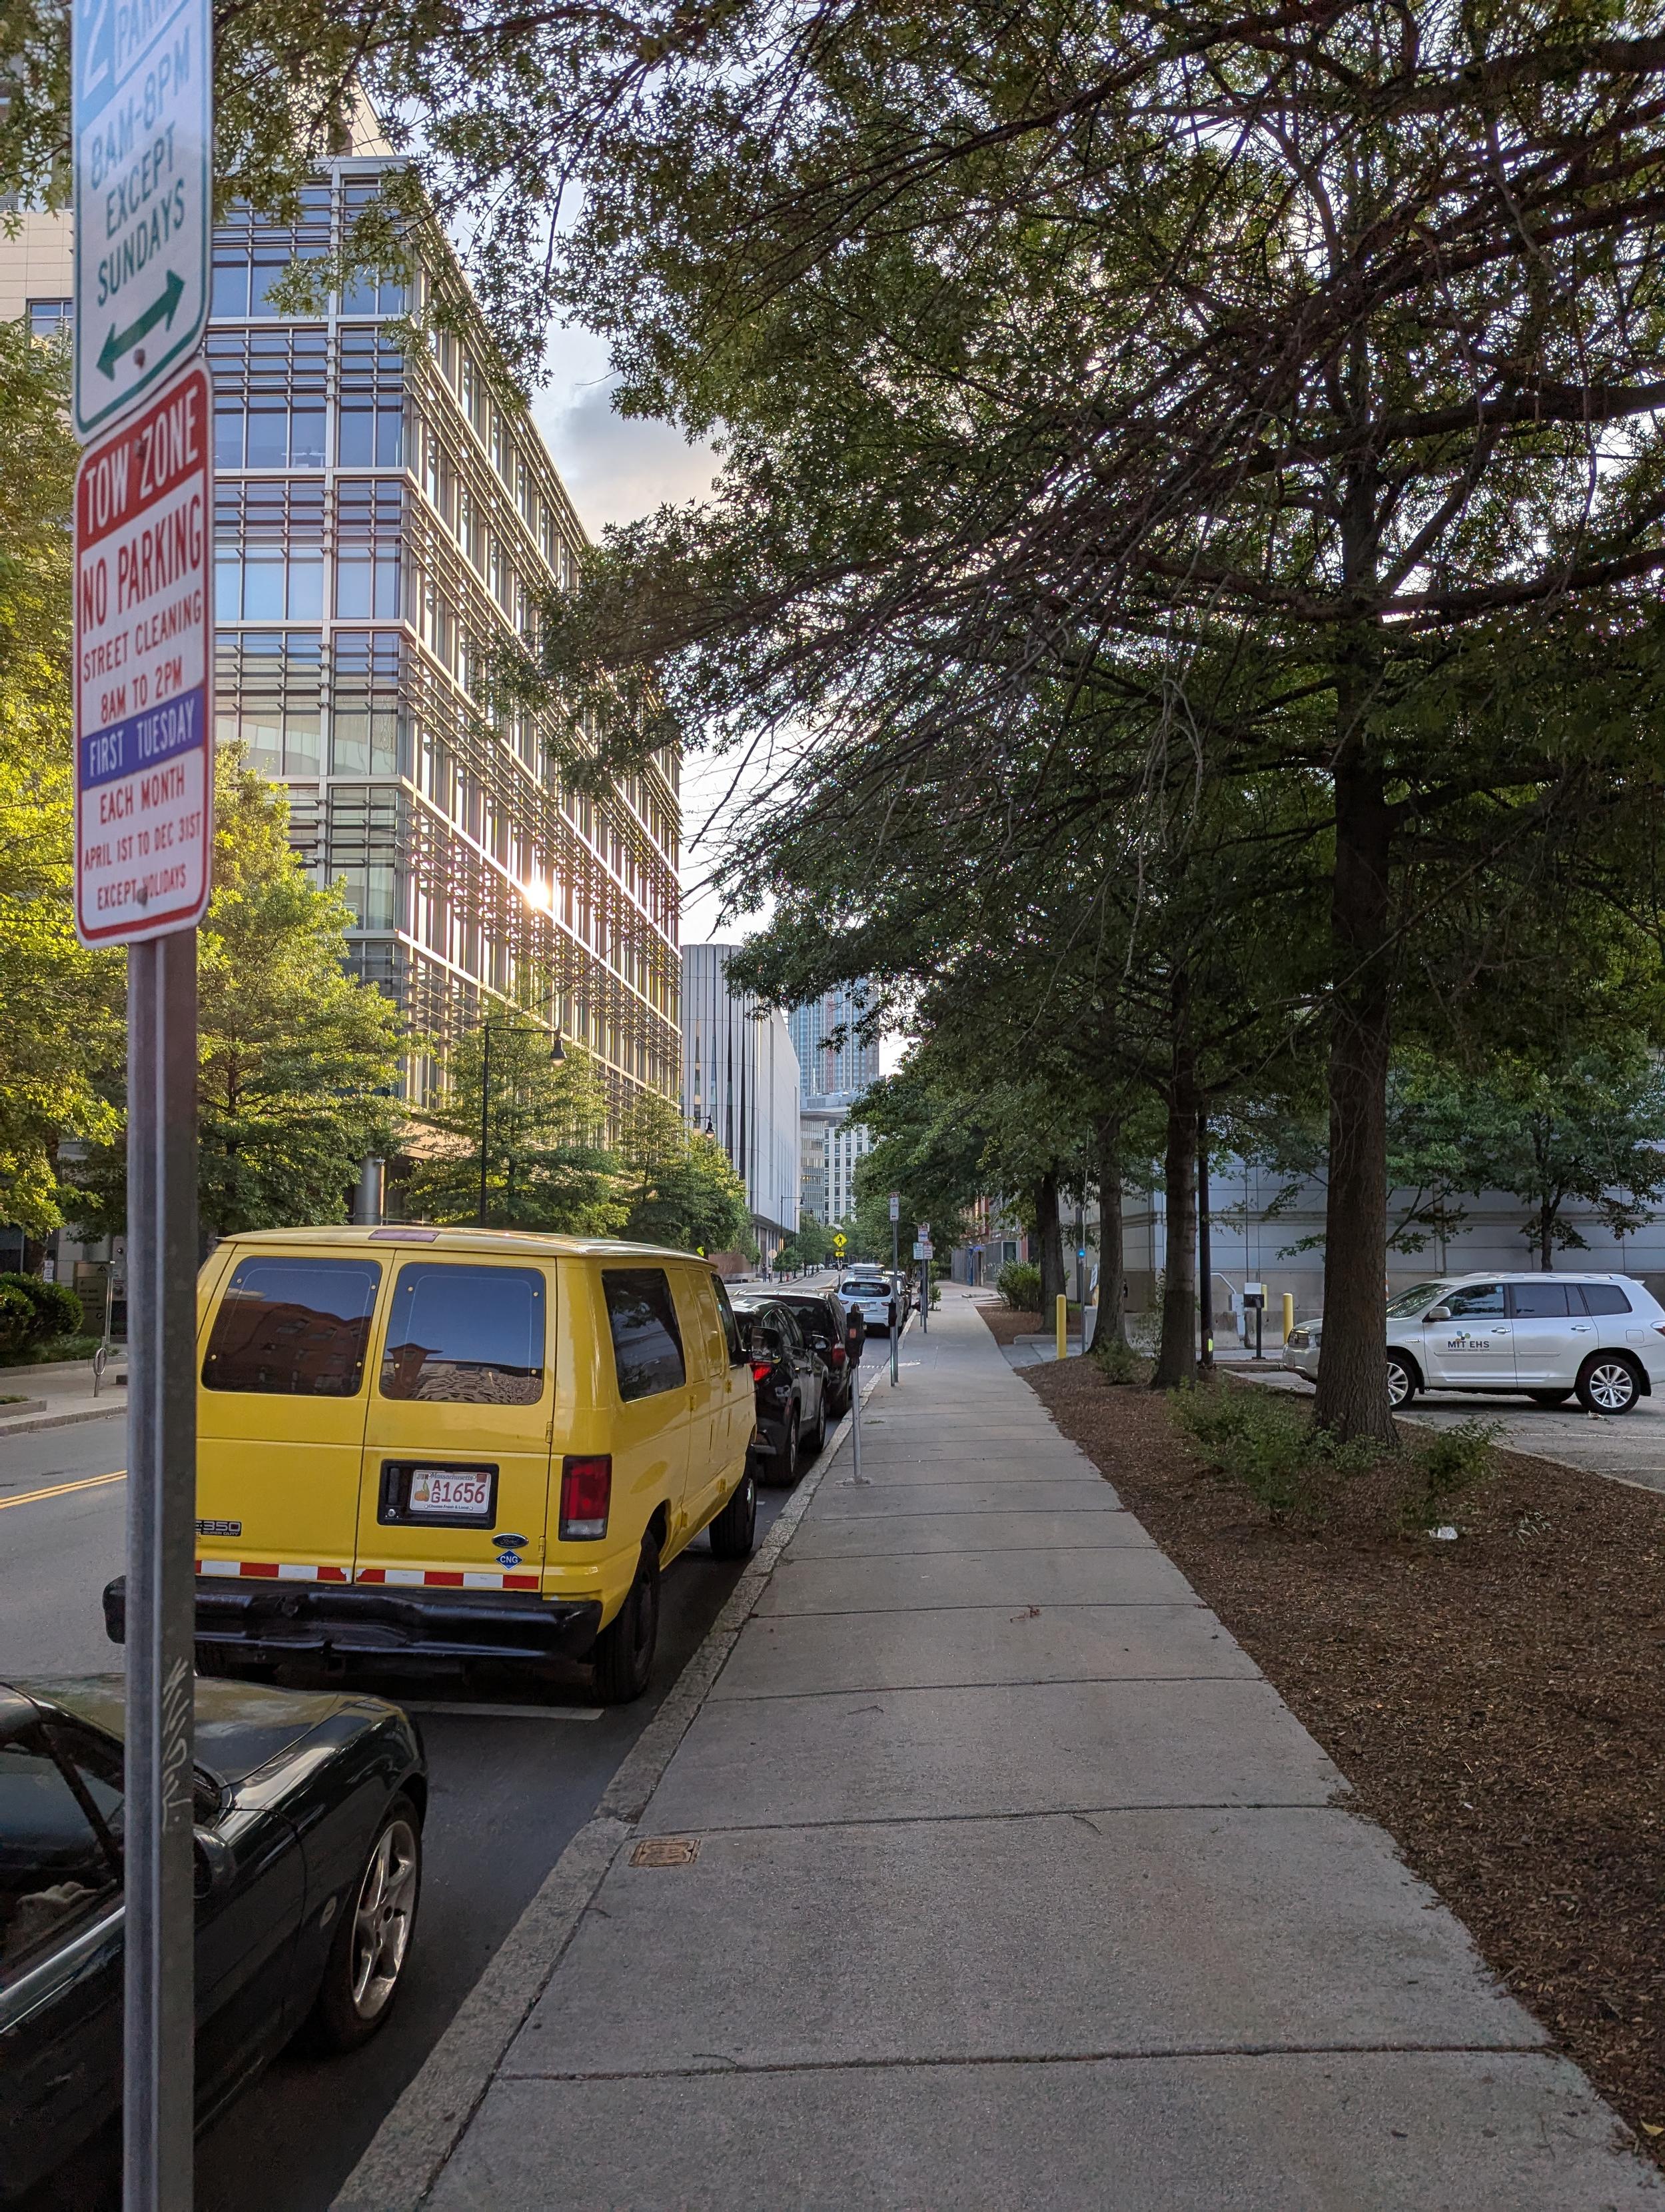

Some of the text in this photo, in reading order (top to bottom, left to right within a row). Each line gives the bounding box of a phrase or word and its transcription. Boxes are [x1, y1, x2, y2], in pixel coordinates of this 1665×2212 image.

[91, 25, 190, 190] 8AM-8PM
[106, 121, 176, 241] EXCEPT
[97, 177, 185, 307] SUNDAYS
[85, 384, 198, 535] TOW ZONE
[83, 494, 201, 634] NO PARKING
[83, 588, 202, 684] STREET CLEANING
[101, 655, 183, 725] 8AM TO 2PM
[89, 697, 195, 778] FIRST TUESDAY
[100, 764, 185, 826] EACH MONTH
[83, 810, 202, 872] APRIL 1ST TO DEC 31ST
[97, 878, 137, 911] EXCEPT
[441, 1482, 486, 1504] 1656
